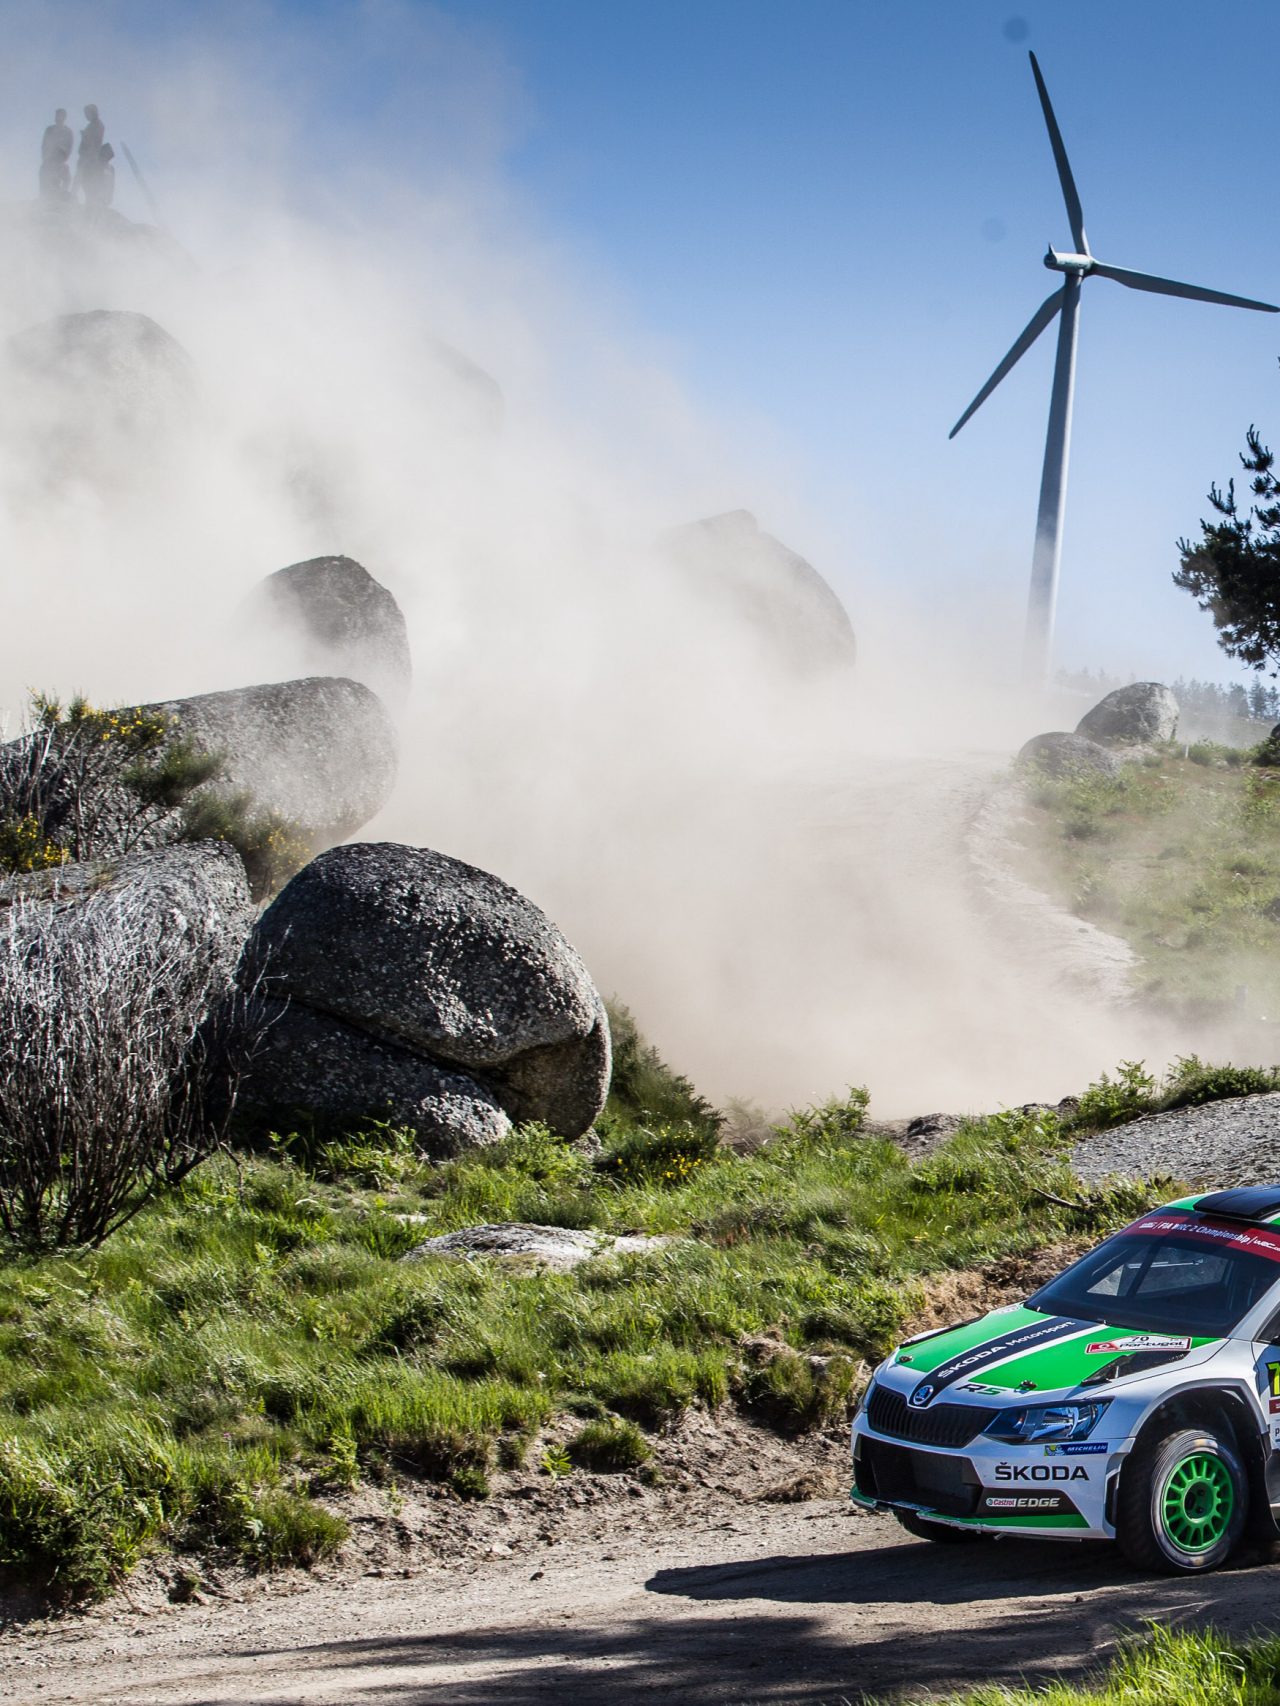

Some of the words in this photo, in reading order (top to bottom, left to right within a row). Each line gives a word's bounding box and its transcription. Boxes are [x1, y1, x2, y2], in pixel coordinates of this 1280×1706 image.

[1196, 1226, 1250, 1244] Championship
[1005, 1321, 1076, 1346] Motorsport
[994, 1462, 1090, 1481] ŠKODA
[993, 1498, 1016, 1506] Castrol
[1017, 1497, 1061, 1508] EDGE
